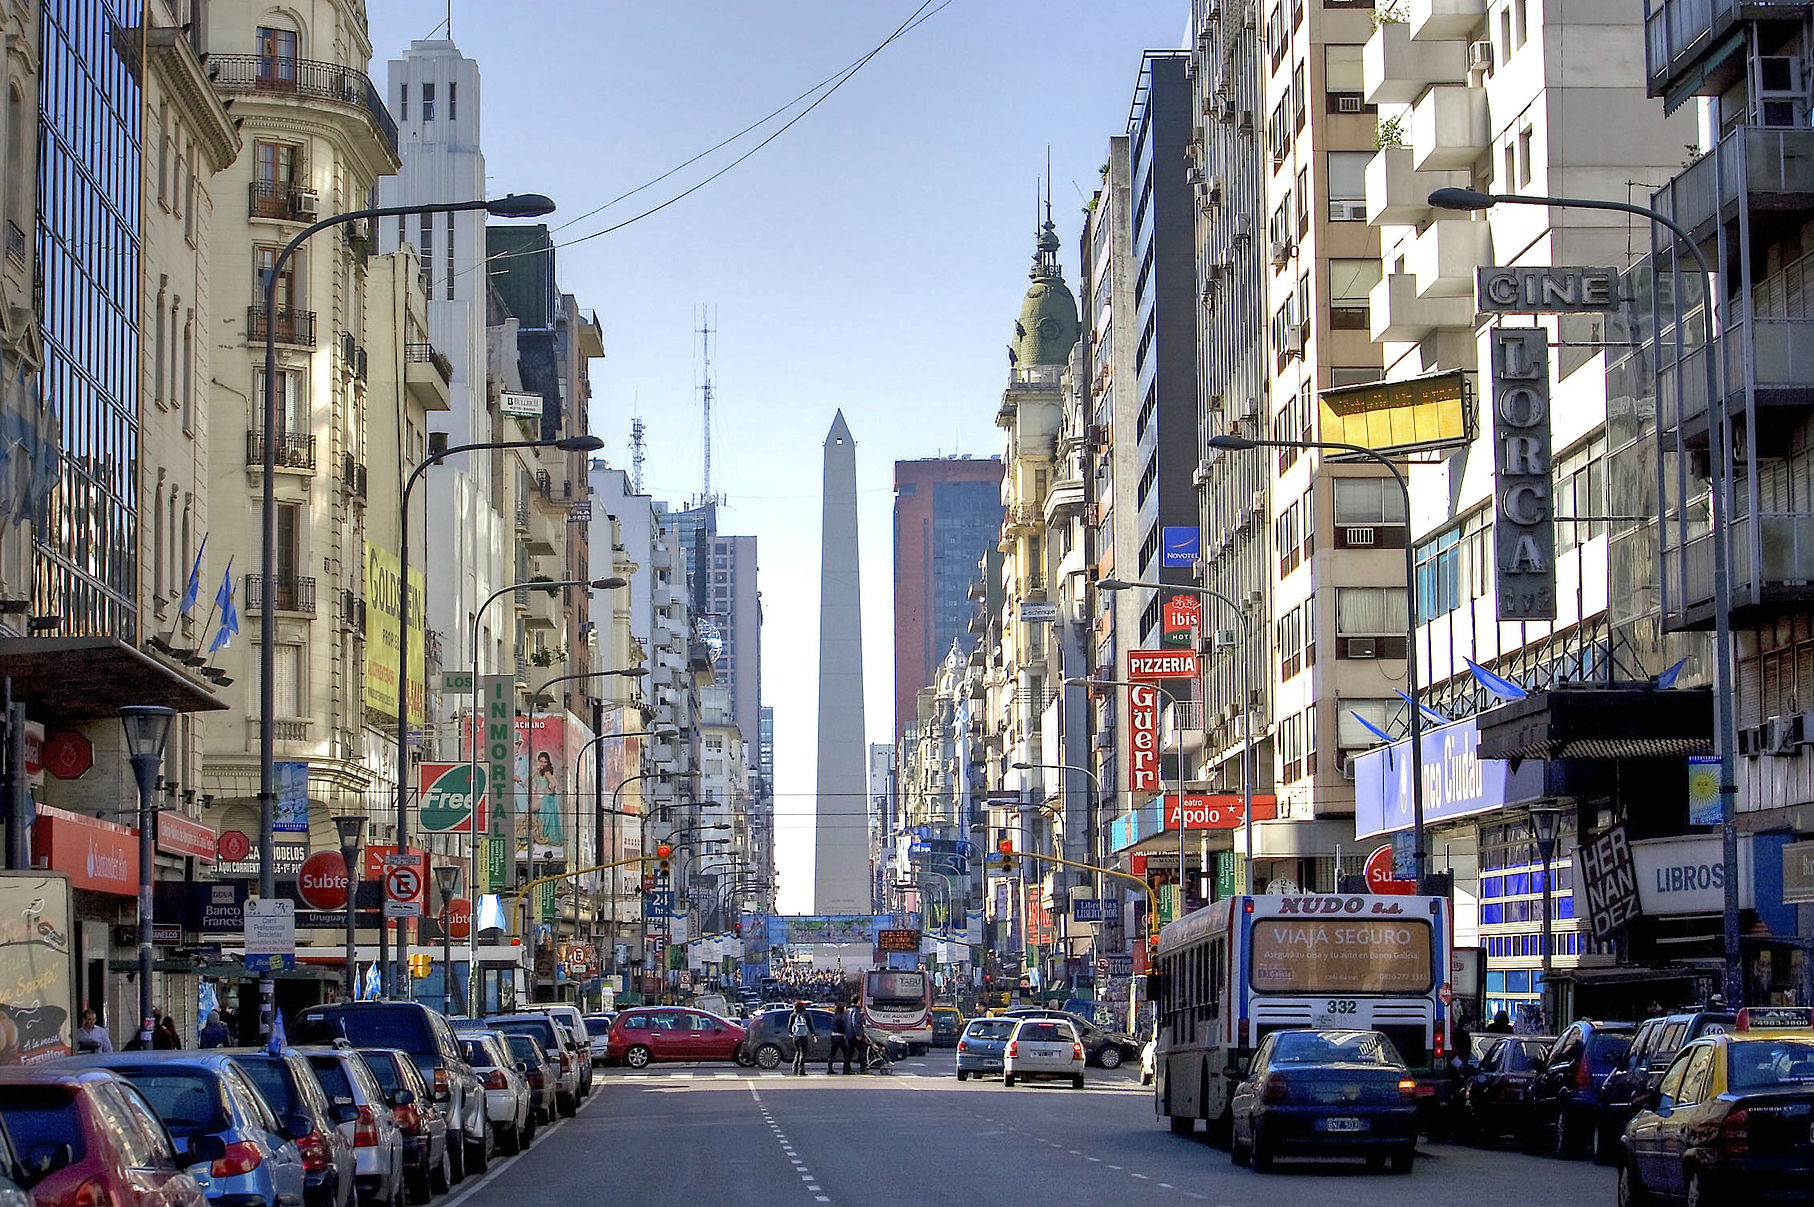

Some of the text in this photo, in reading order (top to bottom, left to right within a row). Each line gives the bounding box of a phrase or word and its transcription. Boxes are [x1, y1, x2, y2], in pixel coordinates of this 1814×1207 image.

[1488, 273, 1610, 306] CINE
[1499, 337, 1548, 573] LORCA
[1167, 552, 1199, 560] NOVOTEL
[370, 547, 421, 631] GOLDSEIN
[1172, 612, 1198, 627] ibis
[1131, 657, 1195, 673] PIZZERIA
[446, 677, 472, 688] LOS
[1412, 732, 1483, 815] nco Ciudad
[1171, 805, 1220, 828] Apolo
[1583, 827, 1629, 880] HER
[304, 874, 349, 889] Subte
[1656, 863, 1725, 893] LIBROS
[212, 890, 233, 898] BBVA
[1589, 862, 1634, 913] NAN
[206, 906, 240, 916] Banco
[1278, 897, 1365, 914] NUDO
[203, 915, 243, 926] Francés
[309, 914, 347, 923] Uruguay
[1593, 895, 1640, 937] DEZ
[1273, 925, 1412, 948] VIAJÁ SEGURO
[1327, 1000, 1357, 1014] 332
